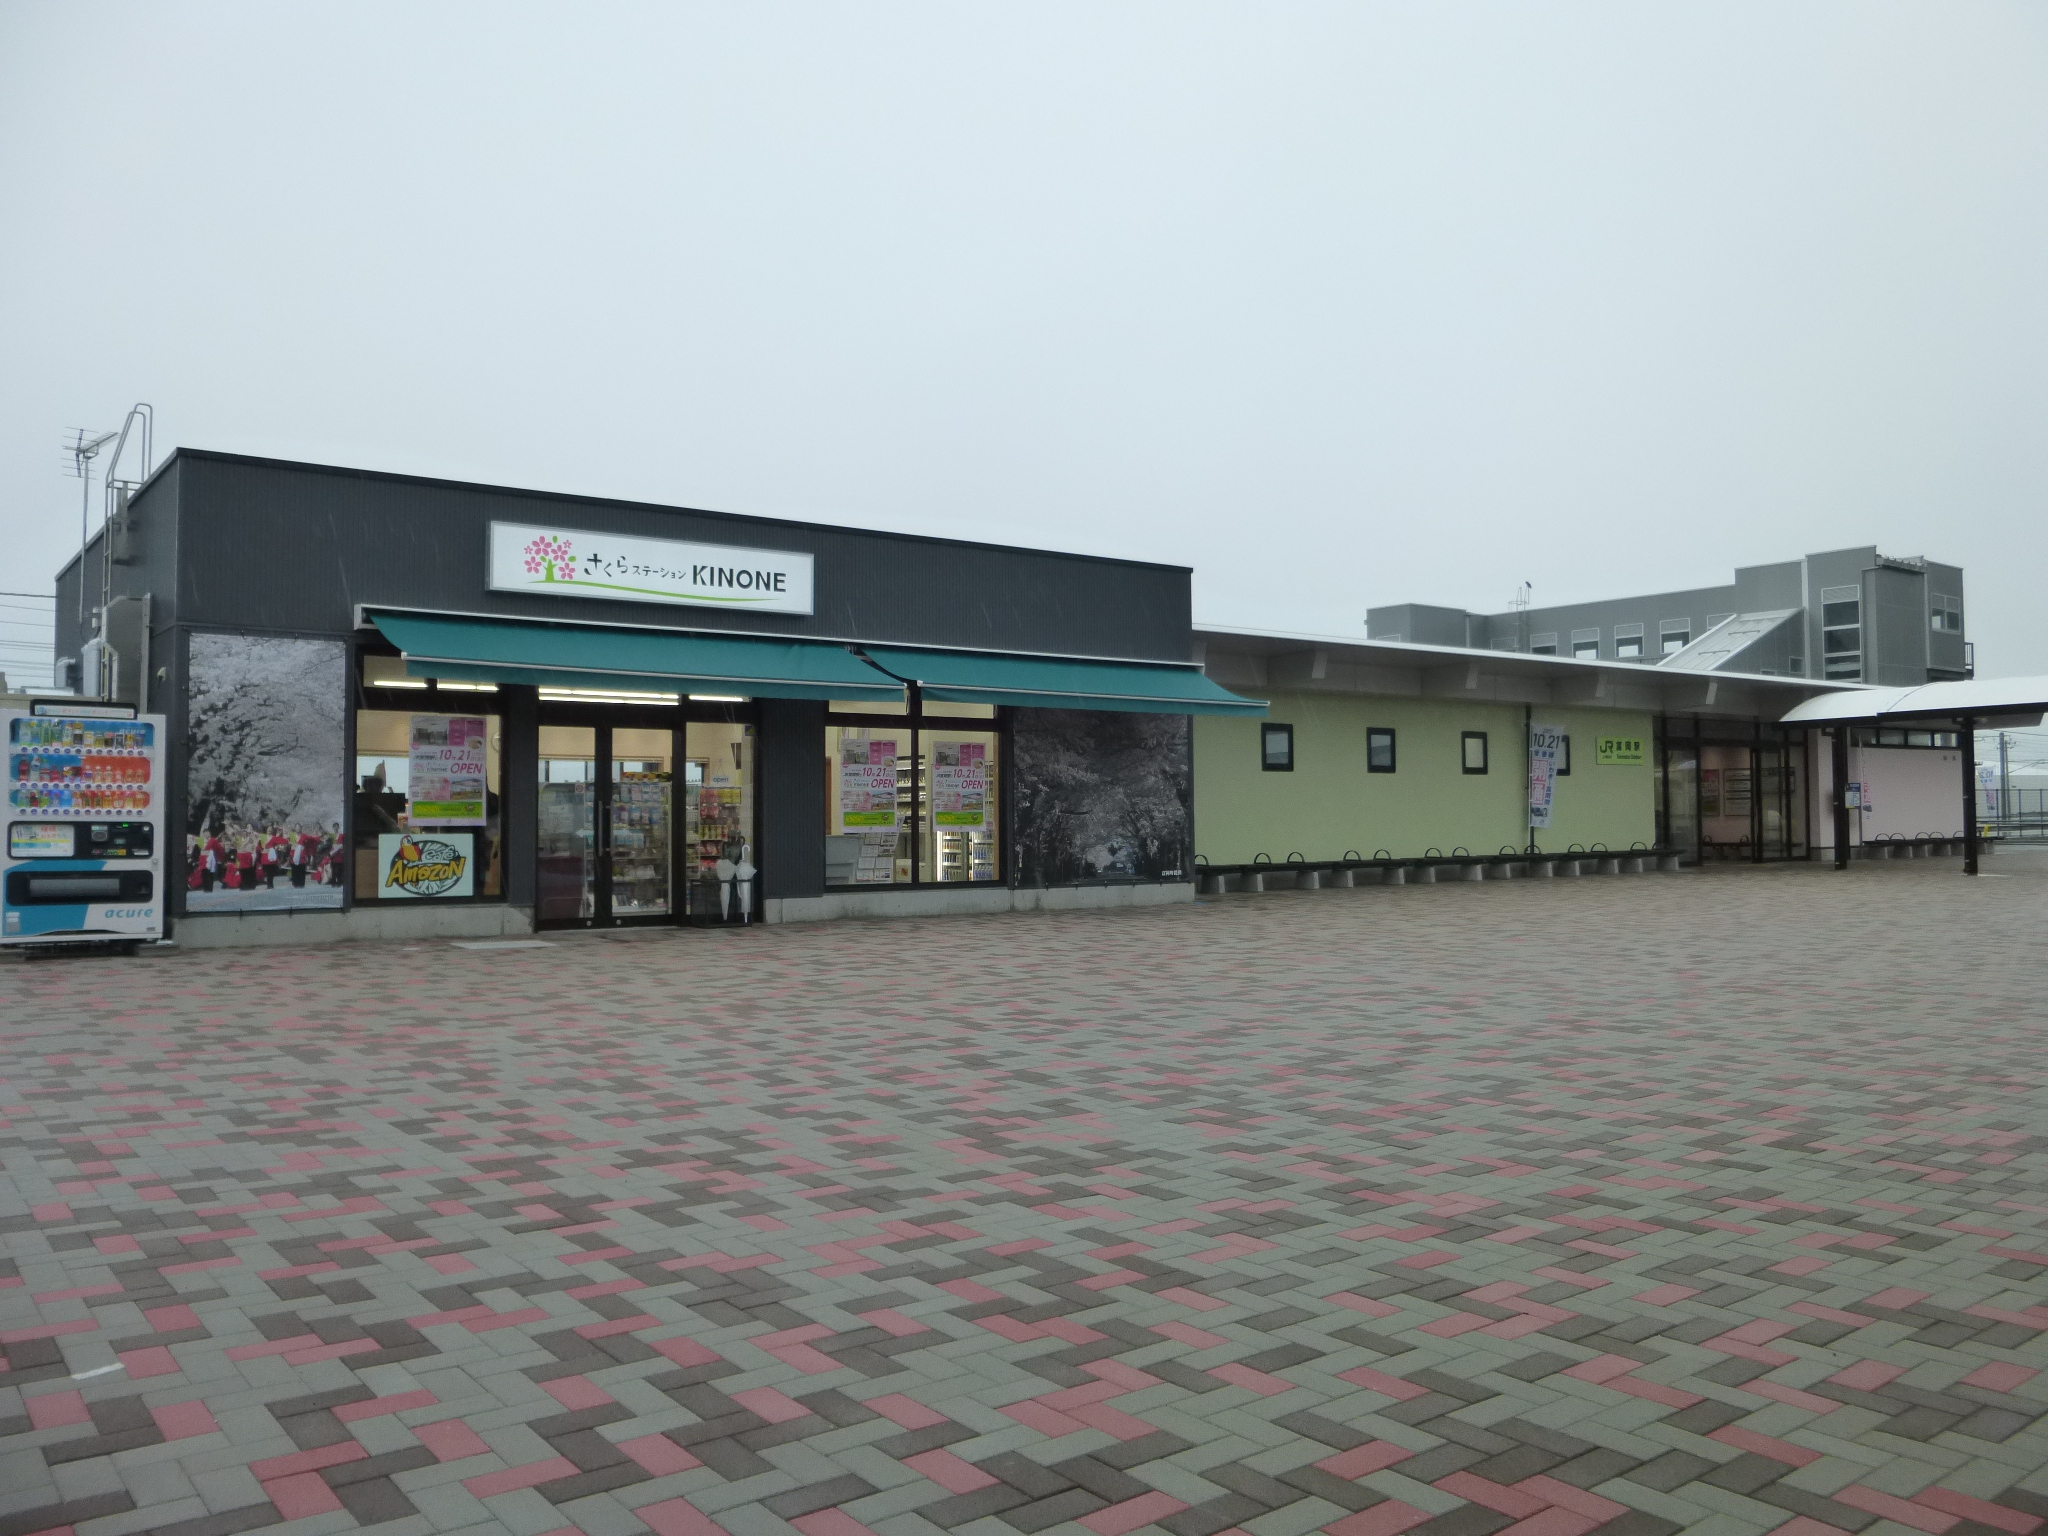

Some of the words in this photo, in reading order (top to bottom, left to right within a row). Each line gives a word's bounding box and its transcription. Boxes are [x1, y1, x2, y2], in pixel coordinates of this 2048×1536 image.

[692, 564, 787, 593] KINONE
[1533, 733, 1560, 749] 10.21
[1600, 740, 1613, 753] JR
[451, 763, 482, 774] OPEN
[871, 778, 895, 788] OPEN
[961, 780, 983, 790] OPEN
[105, 908, 153, 919] acure
